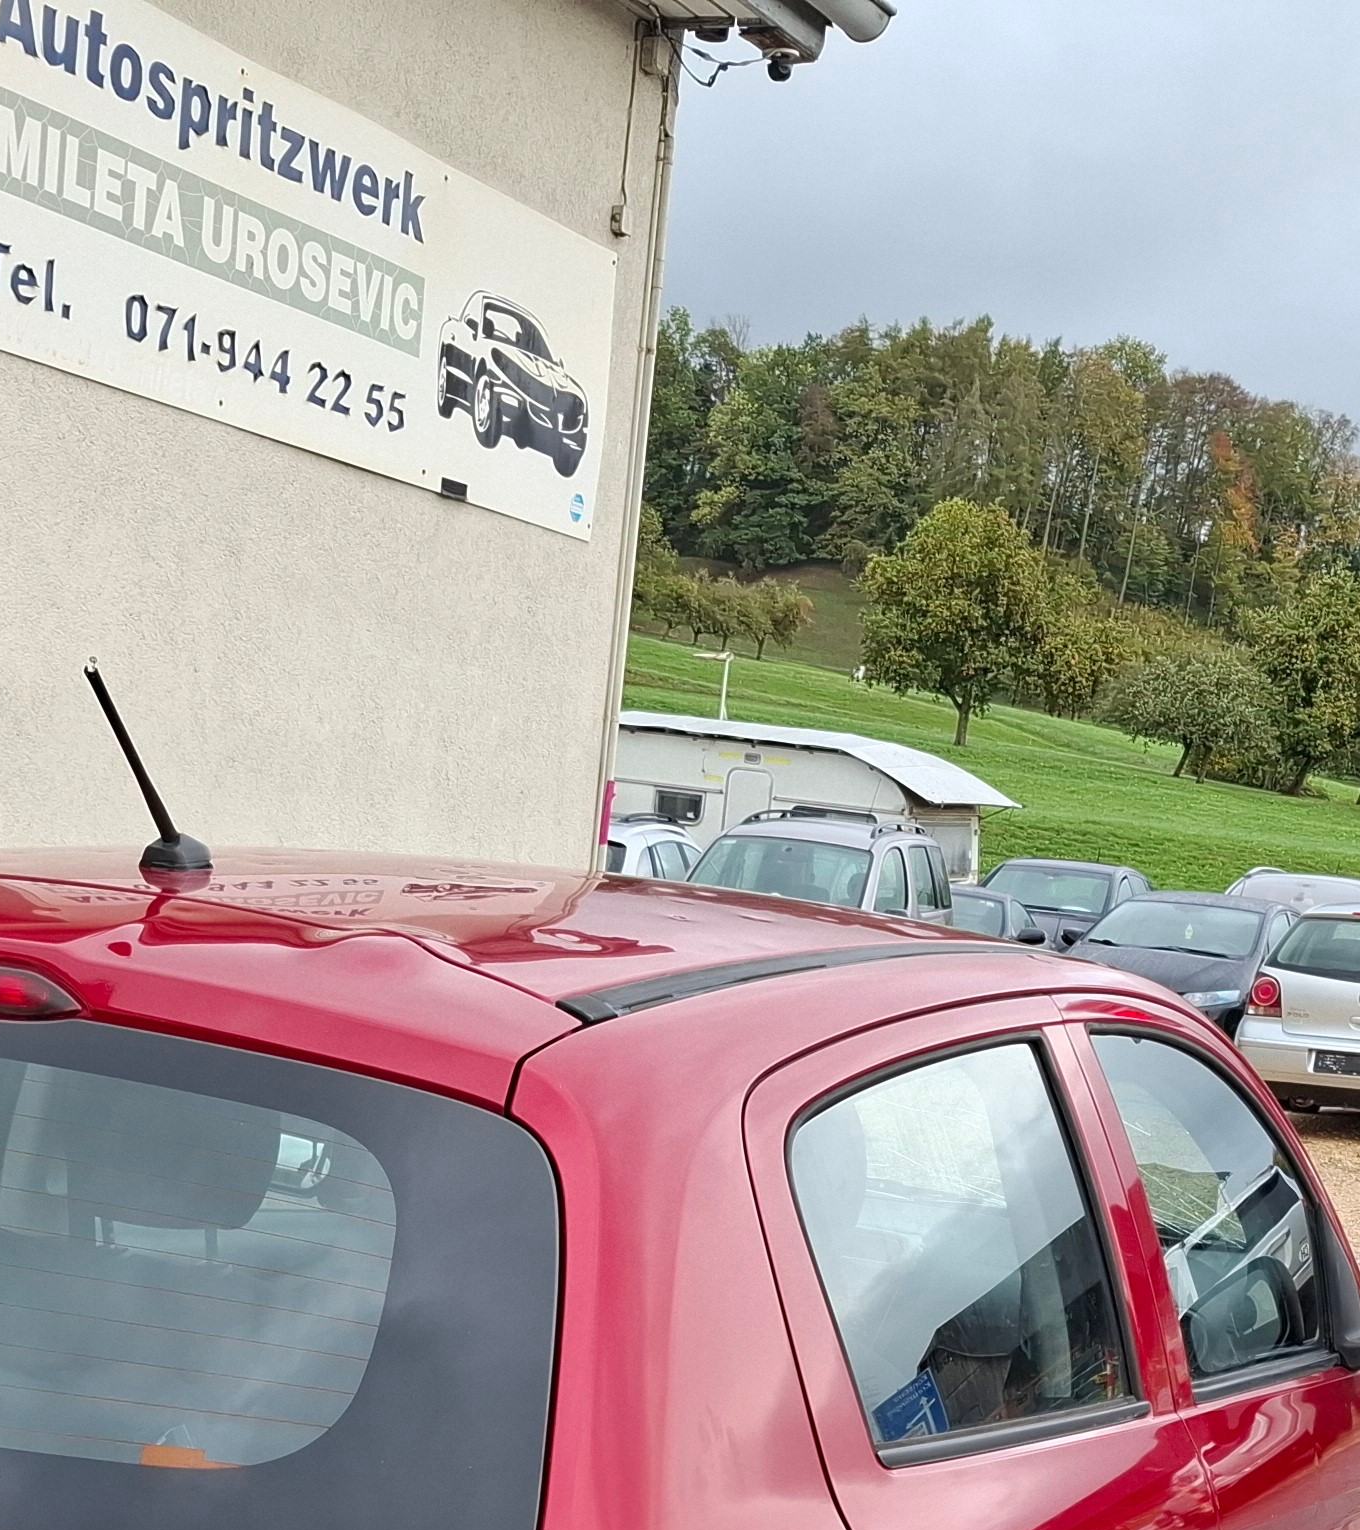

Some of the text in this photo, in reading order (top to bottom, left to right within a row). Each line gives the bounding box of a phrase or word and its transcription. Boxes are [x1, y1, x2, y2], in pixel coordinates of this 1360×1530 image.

[201, 195, 419, 341] UROSEVIC
[124, 294, 292, 394] 071-944
[306, 361, 352, 416] 22
[364, 383, 407, 433] 55
